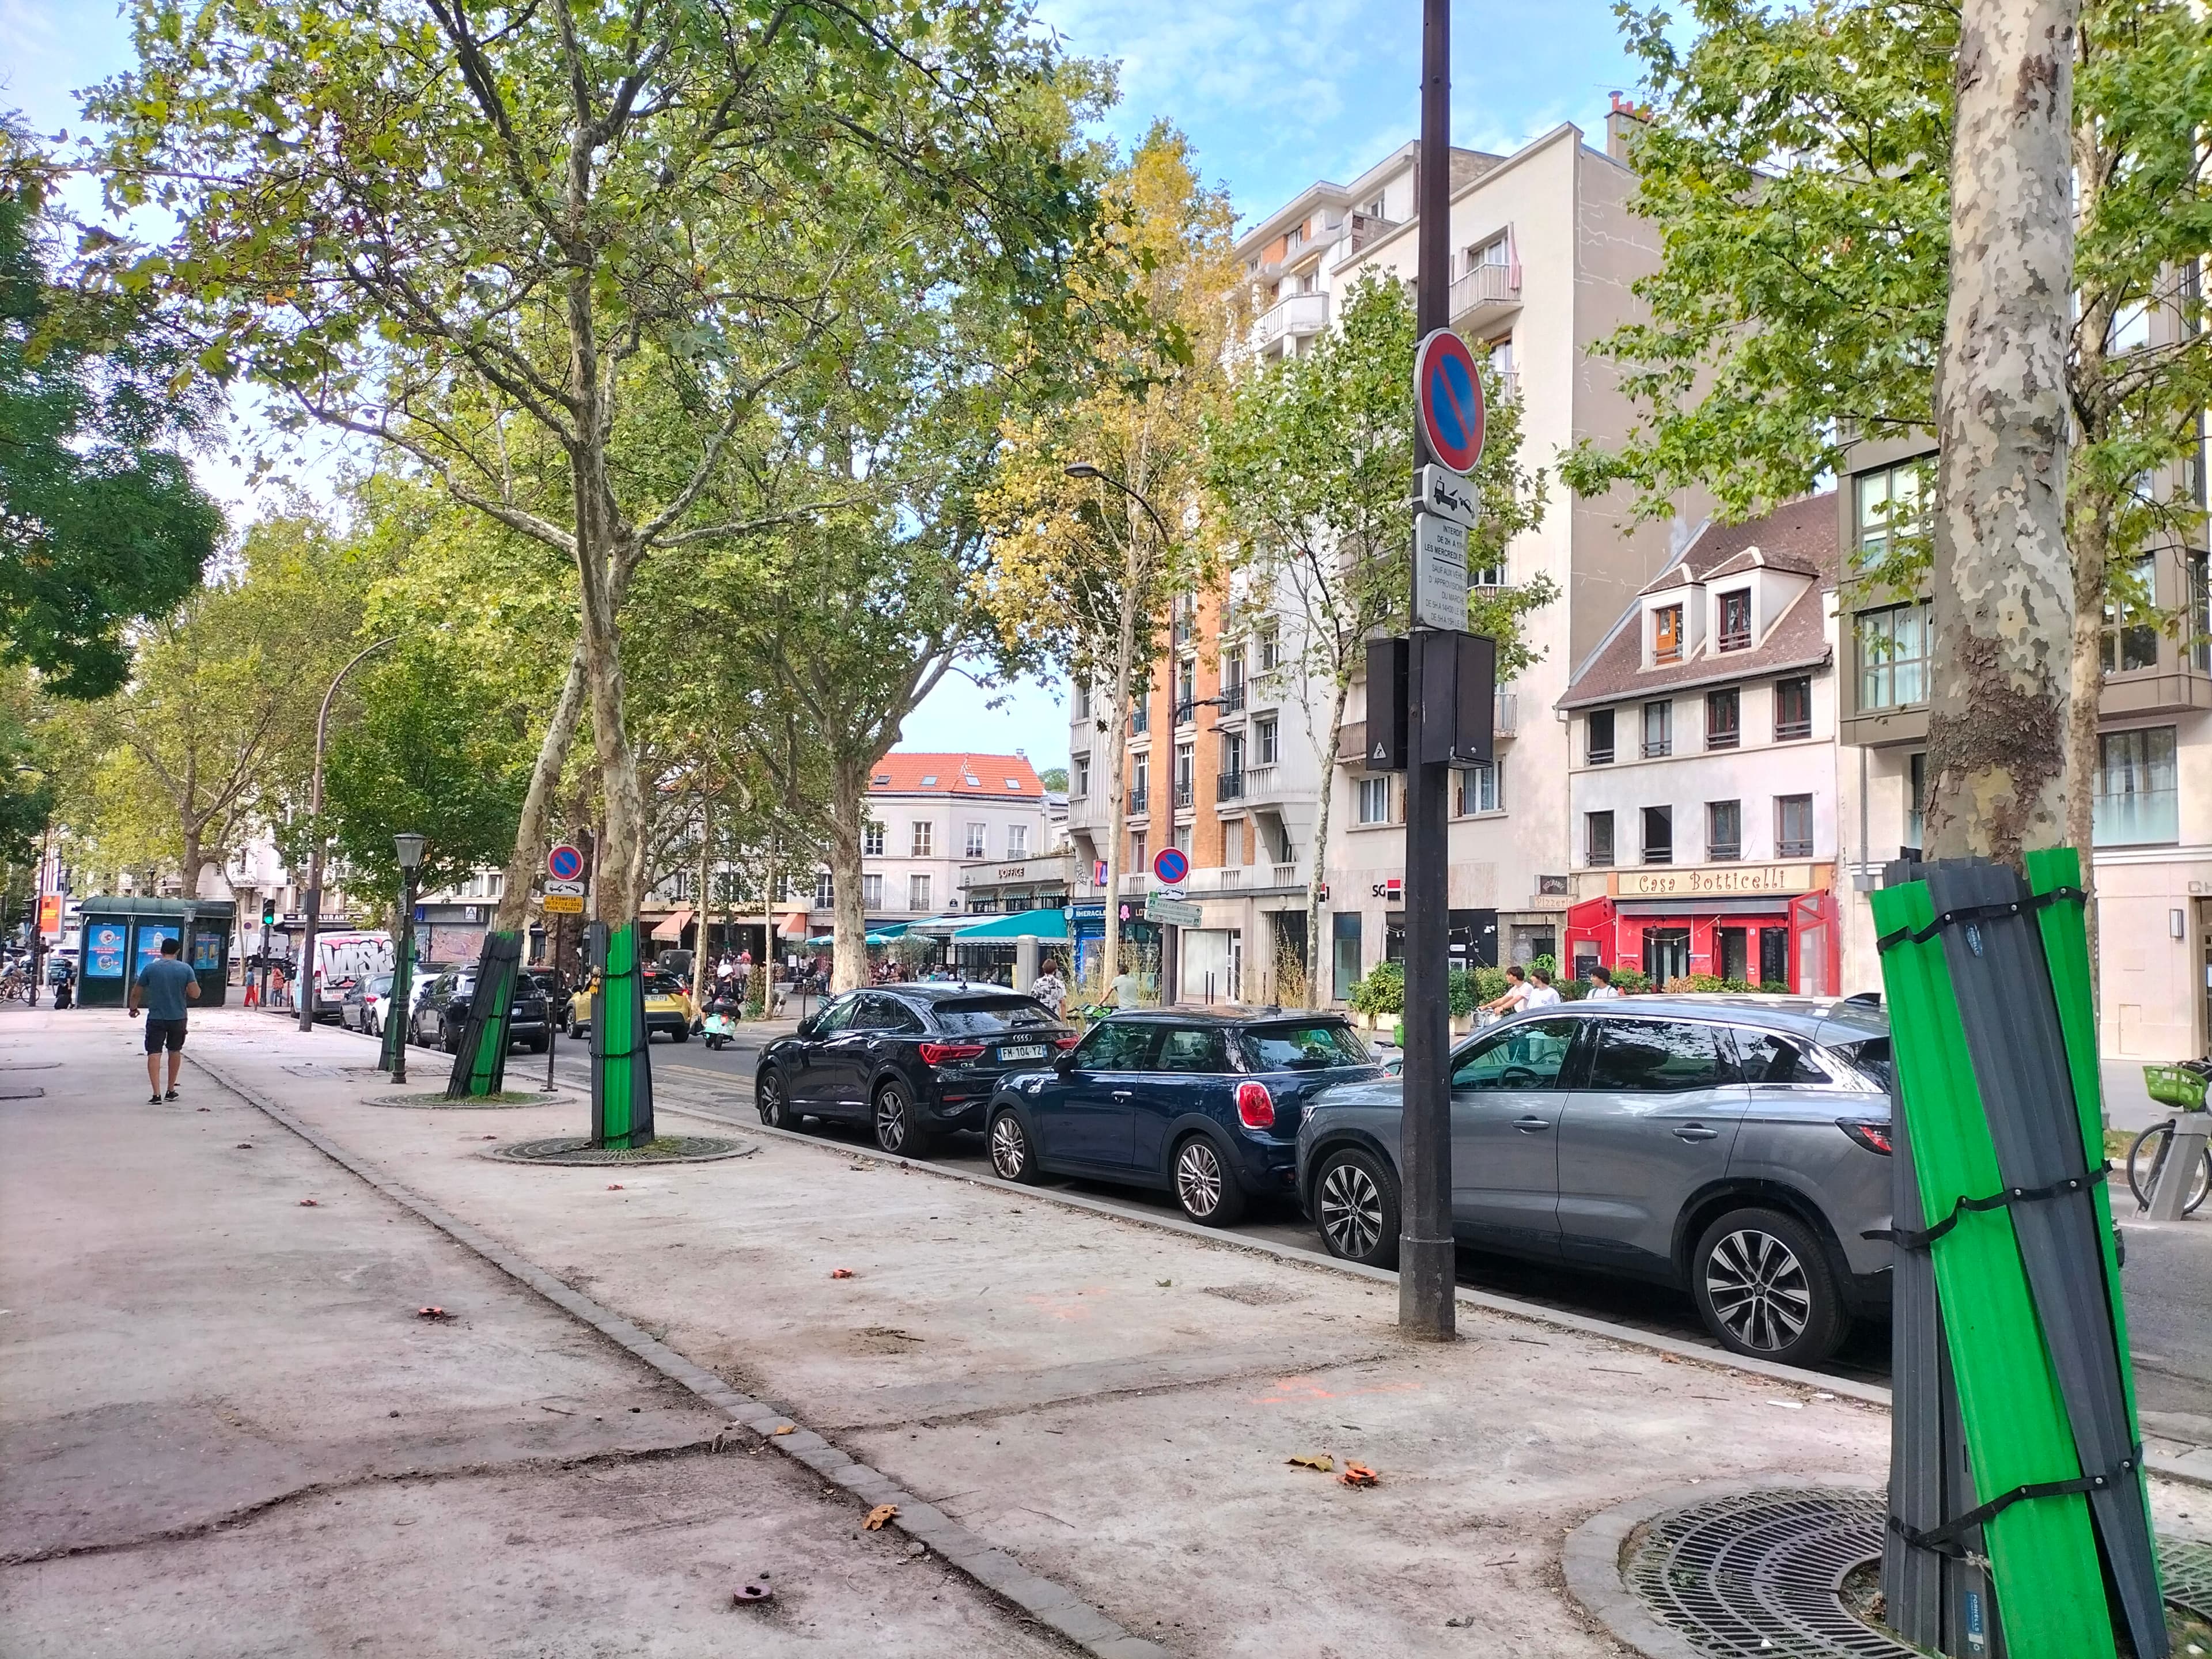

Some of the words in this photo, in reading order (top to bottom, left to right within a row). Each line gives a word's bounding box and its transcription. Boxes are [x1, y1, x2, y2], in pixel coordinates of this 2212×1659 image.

[1442, 525, 1463, 537] INTERDIT
[1437, 535, 1444, 543] DE
[1445, 537, 1450, 546] 2H
[1424, 543, 1434, 552] LES
[1434, 546, 1458, 560] MERCREDI
[1431, 564, 1443, 574] SAUF
[1444, 568, 1452, 577] AUX
[1442, 591, 1448, 600] DU
[1426, 599, 1431, 607] DE
[1454, 607, 1459, 615] LE
[1431, 613, 1437, 621] DE
[1455, 619, 1460, 627] LE
[998, 868, 1024, 878] L'OFFICE
[1639, 875, 1675, 892] Casa
[1690, 868, 1785, 891] Botticelli
[1372, 884, 1385, 897] SG
